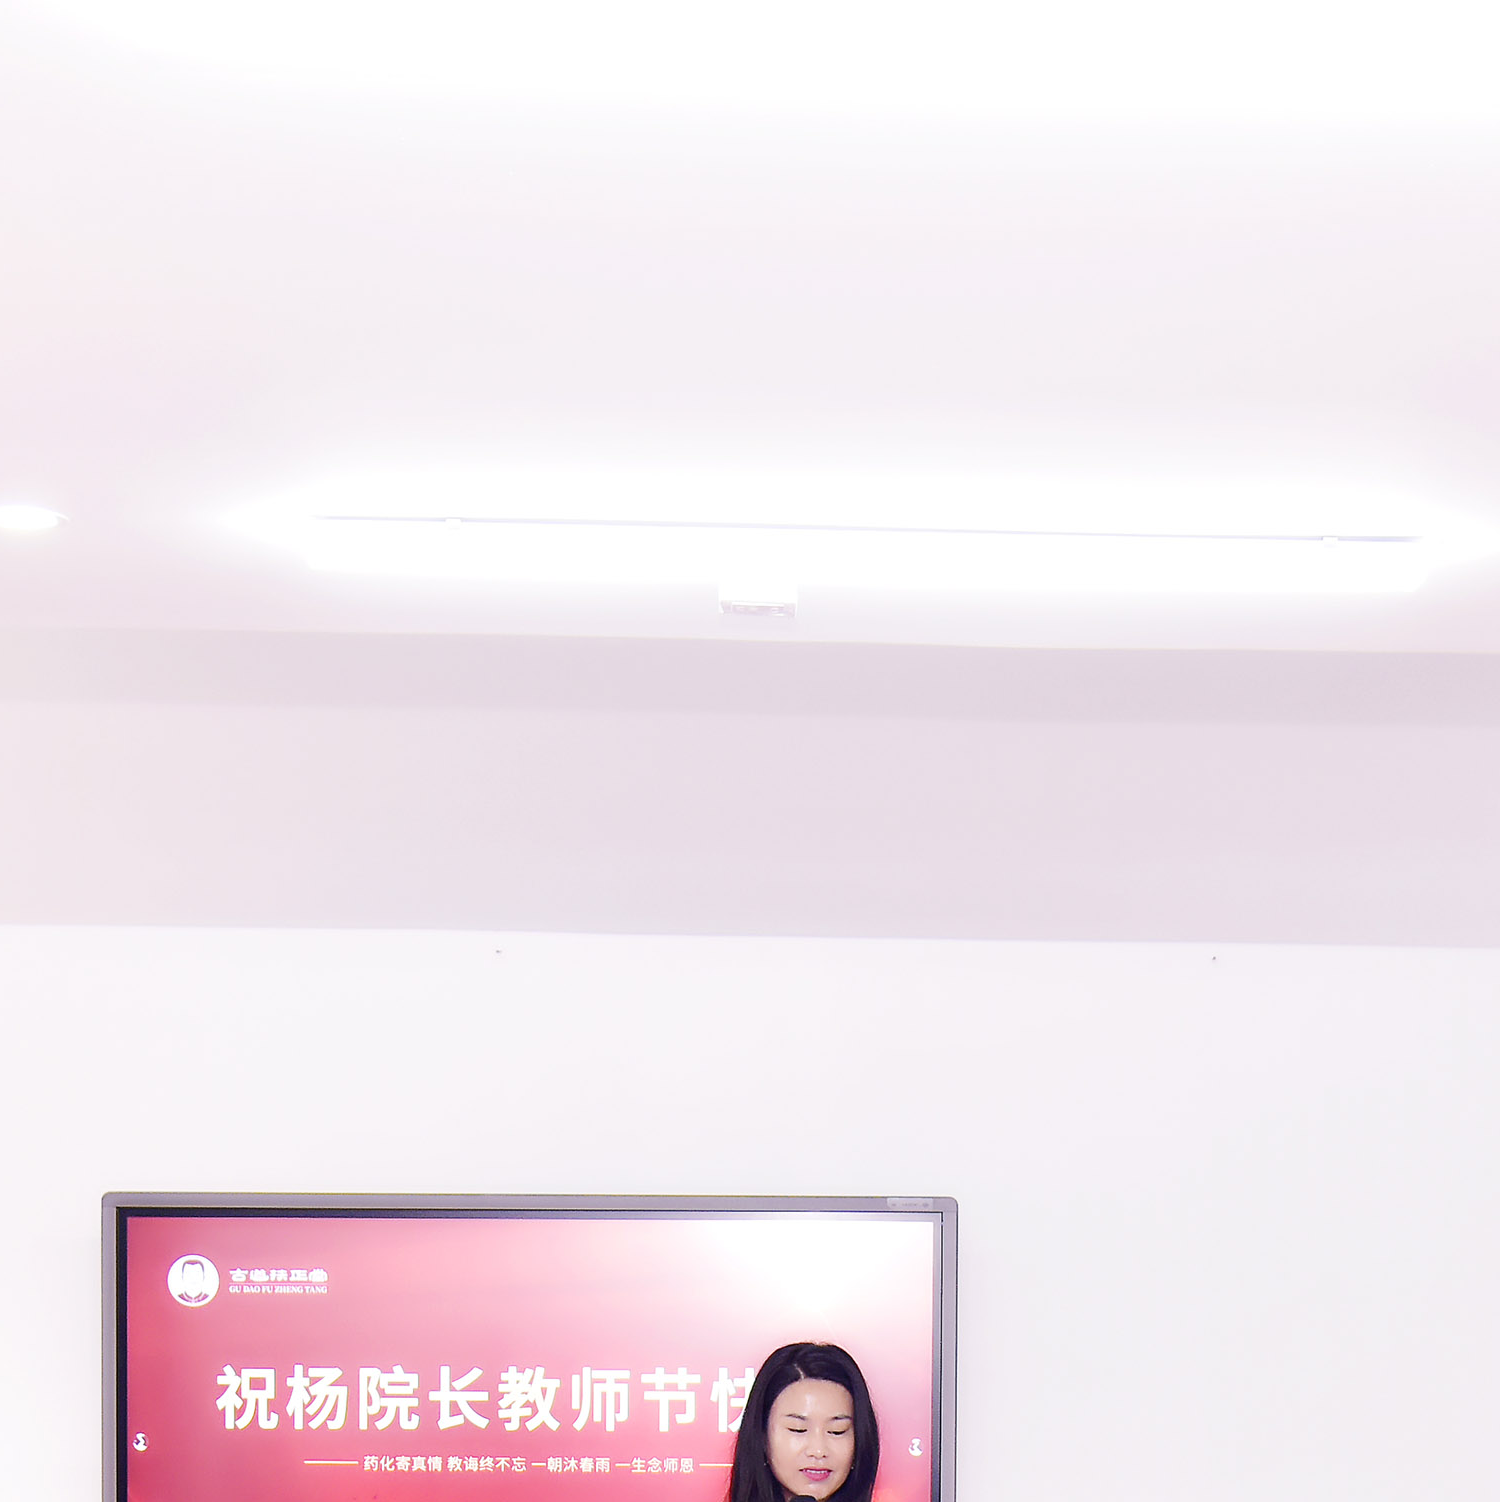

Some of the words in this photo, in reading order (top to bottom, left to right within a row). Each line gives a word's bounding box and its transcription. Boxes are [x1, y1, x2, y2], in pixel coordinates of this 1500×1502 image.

[228, 1285, 241, 1294] GU
[243, 1285, 261, 1294] DAO
[262, 1285, 274, 1294] FU
[274, 1285, 304, 1294] ZHENG
[305, 1285, 328, 1294] TANG
[362, 1455, 443, 1472] 药化寄真情
[446, 1456, 527, 1473] 教诲终不忘
[531, 1456, 611, 1474] 一朝沐春雨
[615, 1457, 695, 1474] 一生念师恩
